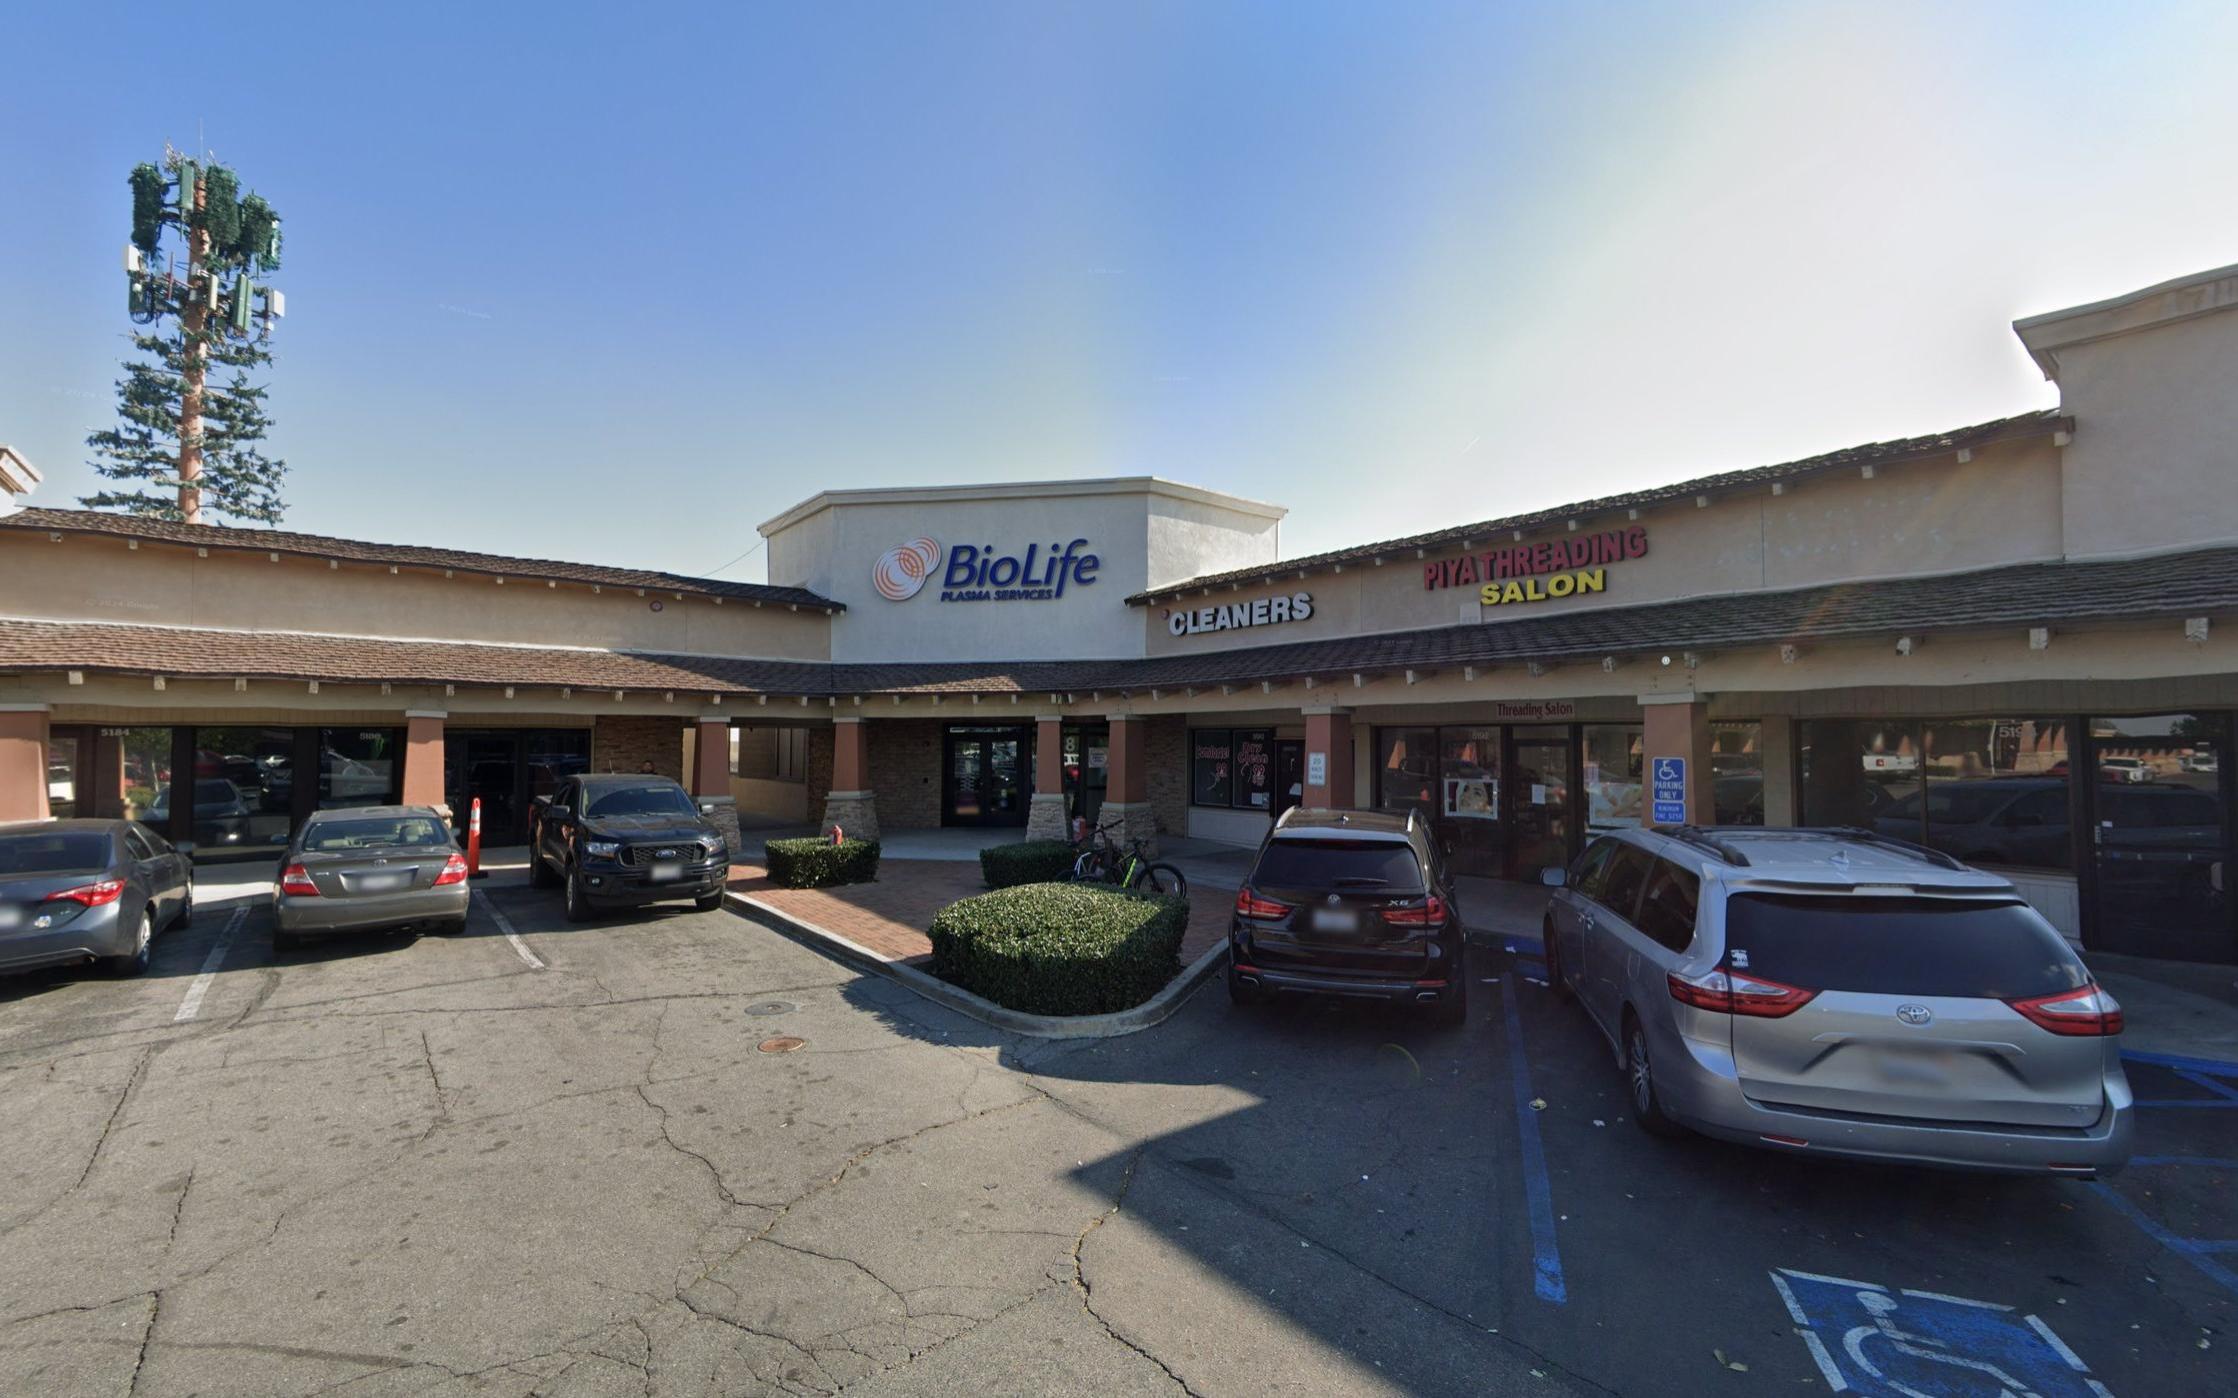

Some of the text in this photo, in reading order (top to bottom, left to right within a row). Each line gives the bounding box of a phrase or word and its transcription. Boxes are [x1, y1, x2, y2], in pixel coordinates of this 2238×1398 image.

[1423, 526, 1648, 591] PIYA THREADING
[943, 538, 1100, 598] BioLife
[941, 588, 1053, 601] PLASMA SERVICES
[1480, 568, 1607, 606] SALON
[1169, 592, 1315, 636] CLEANERS
[1497, 702, 1573, 719] Threading Salon
[101, 728, 129, 737] 5184
[1655, 781, 1683, 791] PARKING
[1659, 791, 1677, 800] ONLY
